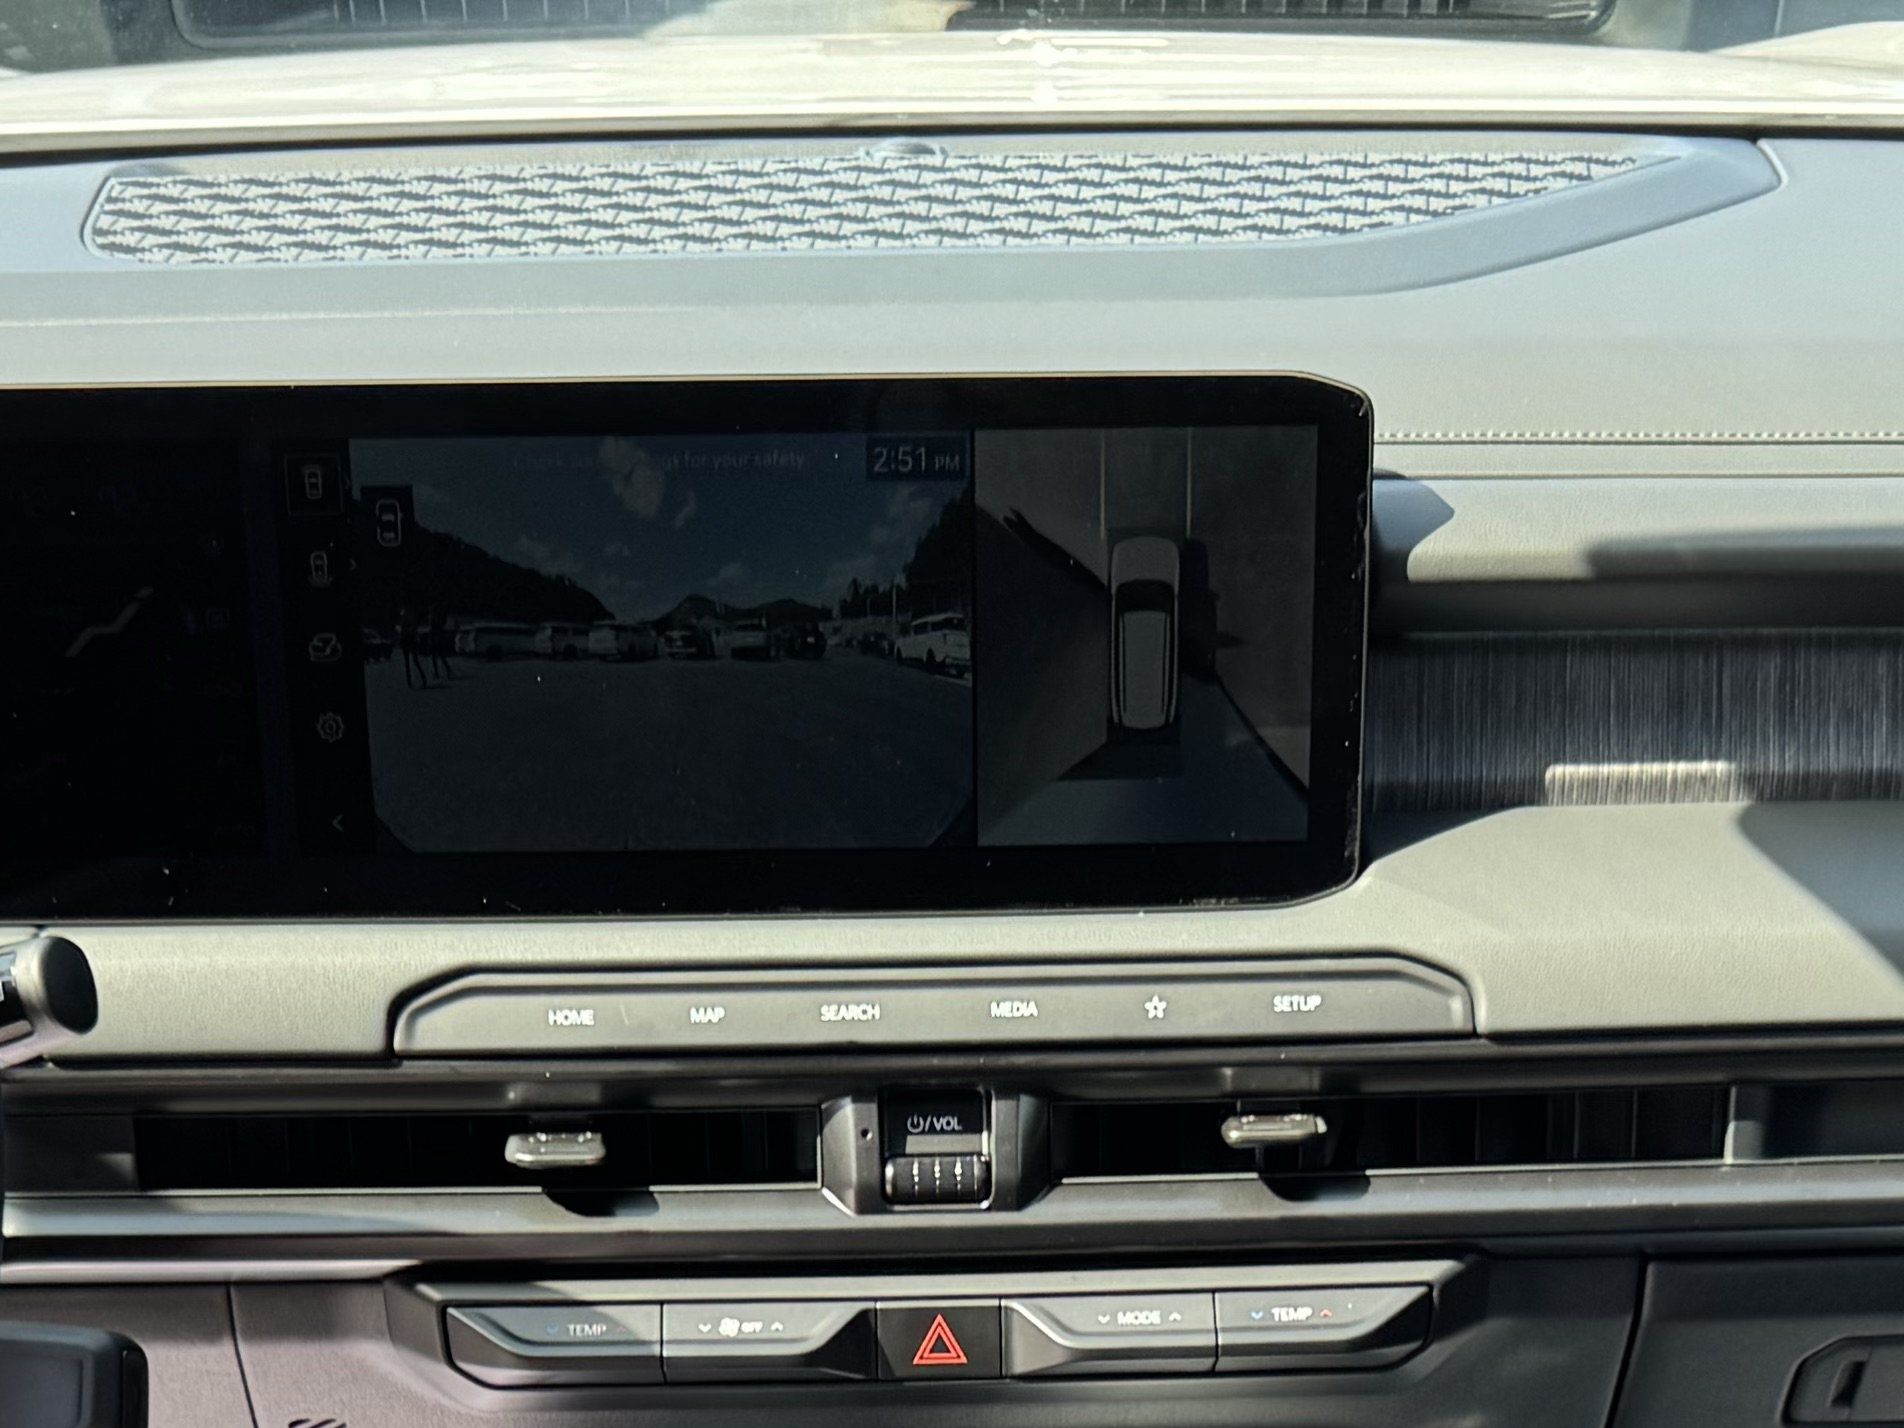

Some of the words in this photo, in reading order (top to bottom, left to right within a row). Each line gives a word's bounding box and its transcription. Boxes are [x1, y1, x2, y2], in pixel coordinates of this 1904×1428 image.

[873, 446, 929, 472] 2:51
[934, 455, 960, 470] PM
[820, 1003, 880, 1022] SEARCH
[990, 1000, 1038, 1018] MEDIA
[1273, 995, 1322, 1013] SETUP
[548, 1009, 594, 1026] HOME
[690, 1006, 726, 1024] MAP
[1117, 1310, 1161, 1325] MODE
[1271, 1307, 1313, 1322] TEMP
[567, 1323, 607, 1337] TEMP
